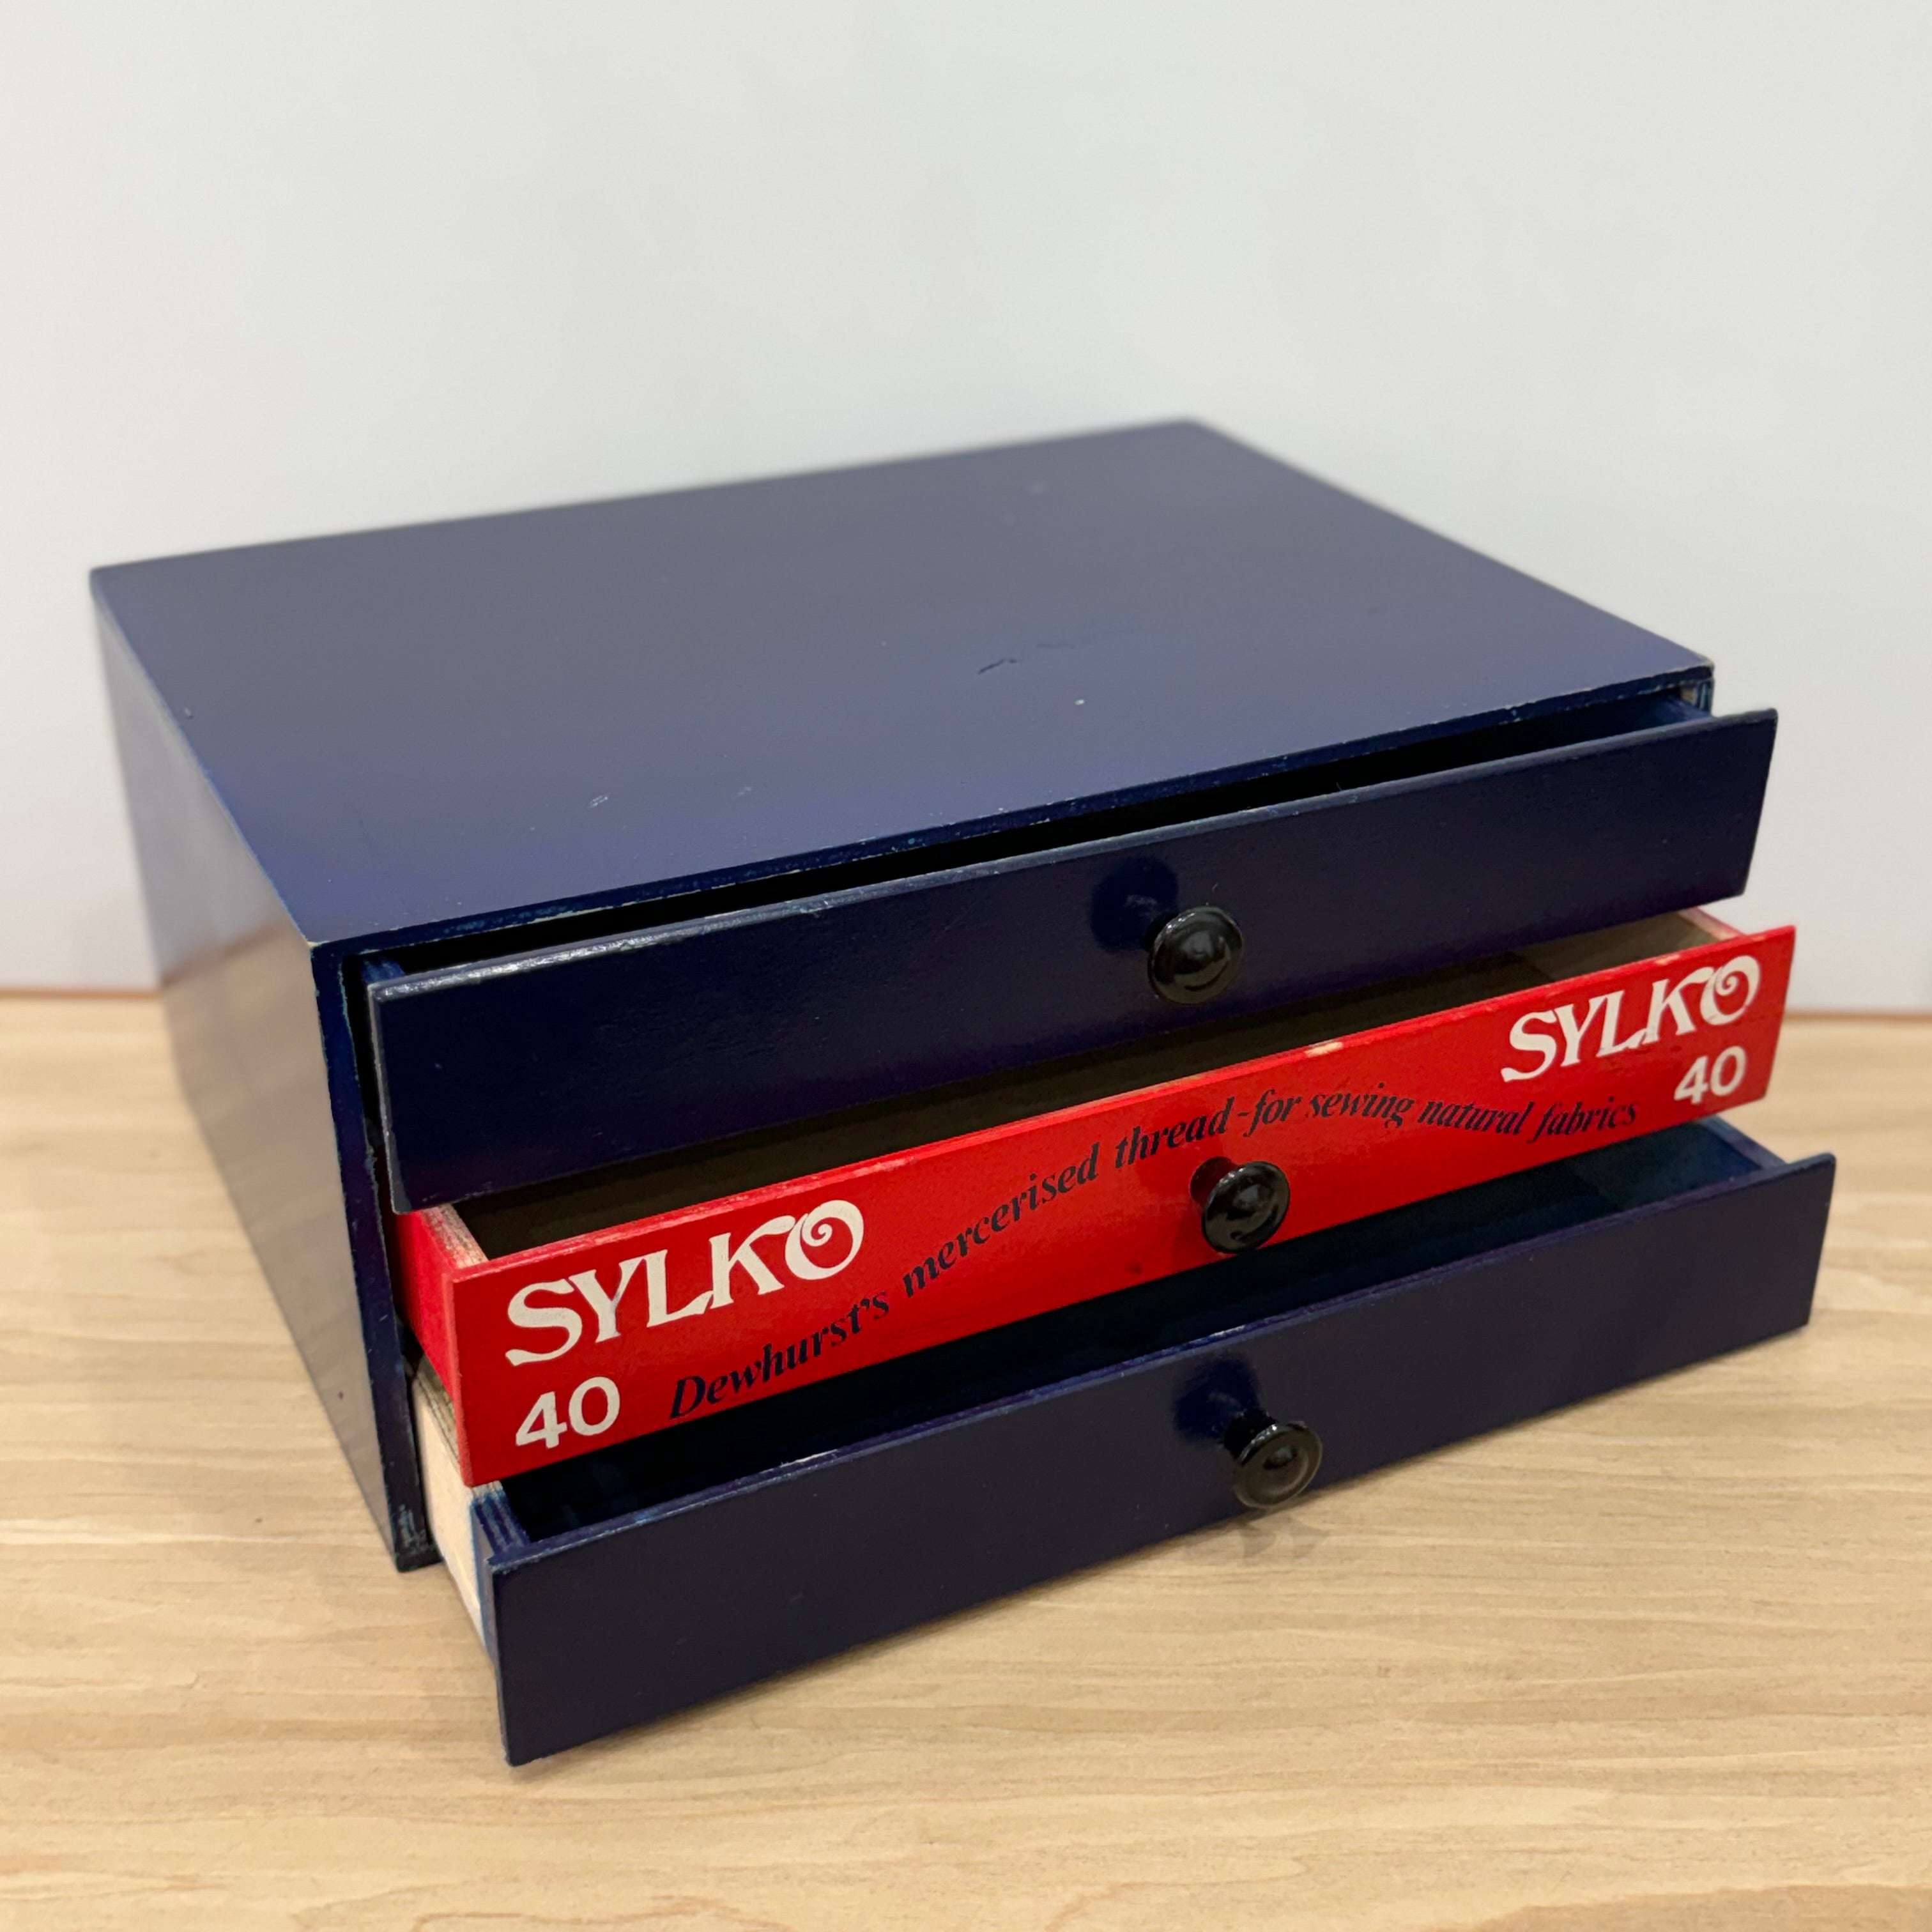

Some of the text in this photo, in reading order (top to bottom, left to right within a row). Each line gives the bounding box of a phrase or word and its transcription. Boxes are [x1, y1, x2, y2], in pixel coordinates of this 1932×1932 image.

[1501, 955, 1760, 1082] SYLKO
[1673, 1045, 1747, 1105] 40
[505, 1199, 864, 1367] SYLKO
[668, 1290, 890, 1420] Dewhurst's
[901, 1144, 1100, 1299] mercerised
[1114, 1096, 1236, 1169] thread
[1305, 1082, 1414, 1130] sewing
[1417, 1100, 1536, 1136] natural
[1526, 1096, 1641, 1145] fabrics
[515, 1376, 620, 1449] 40
